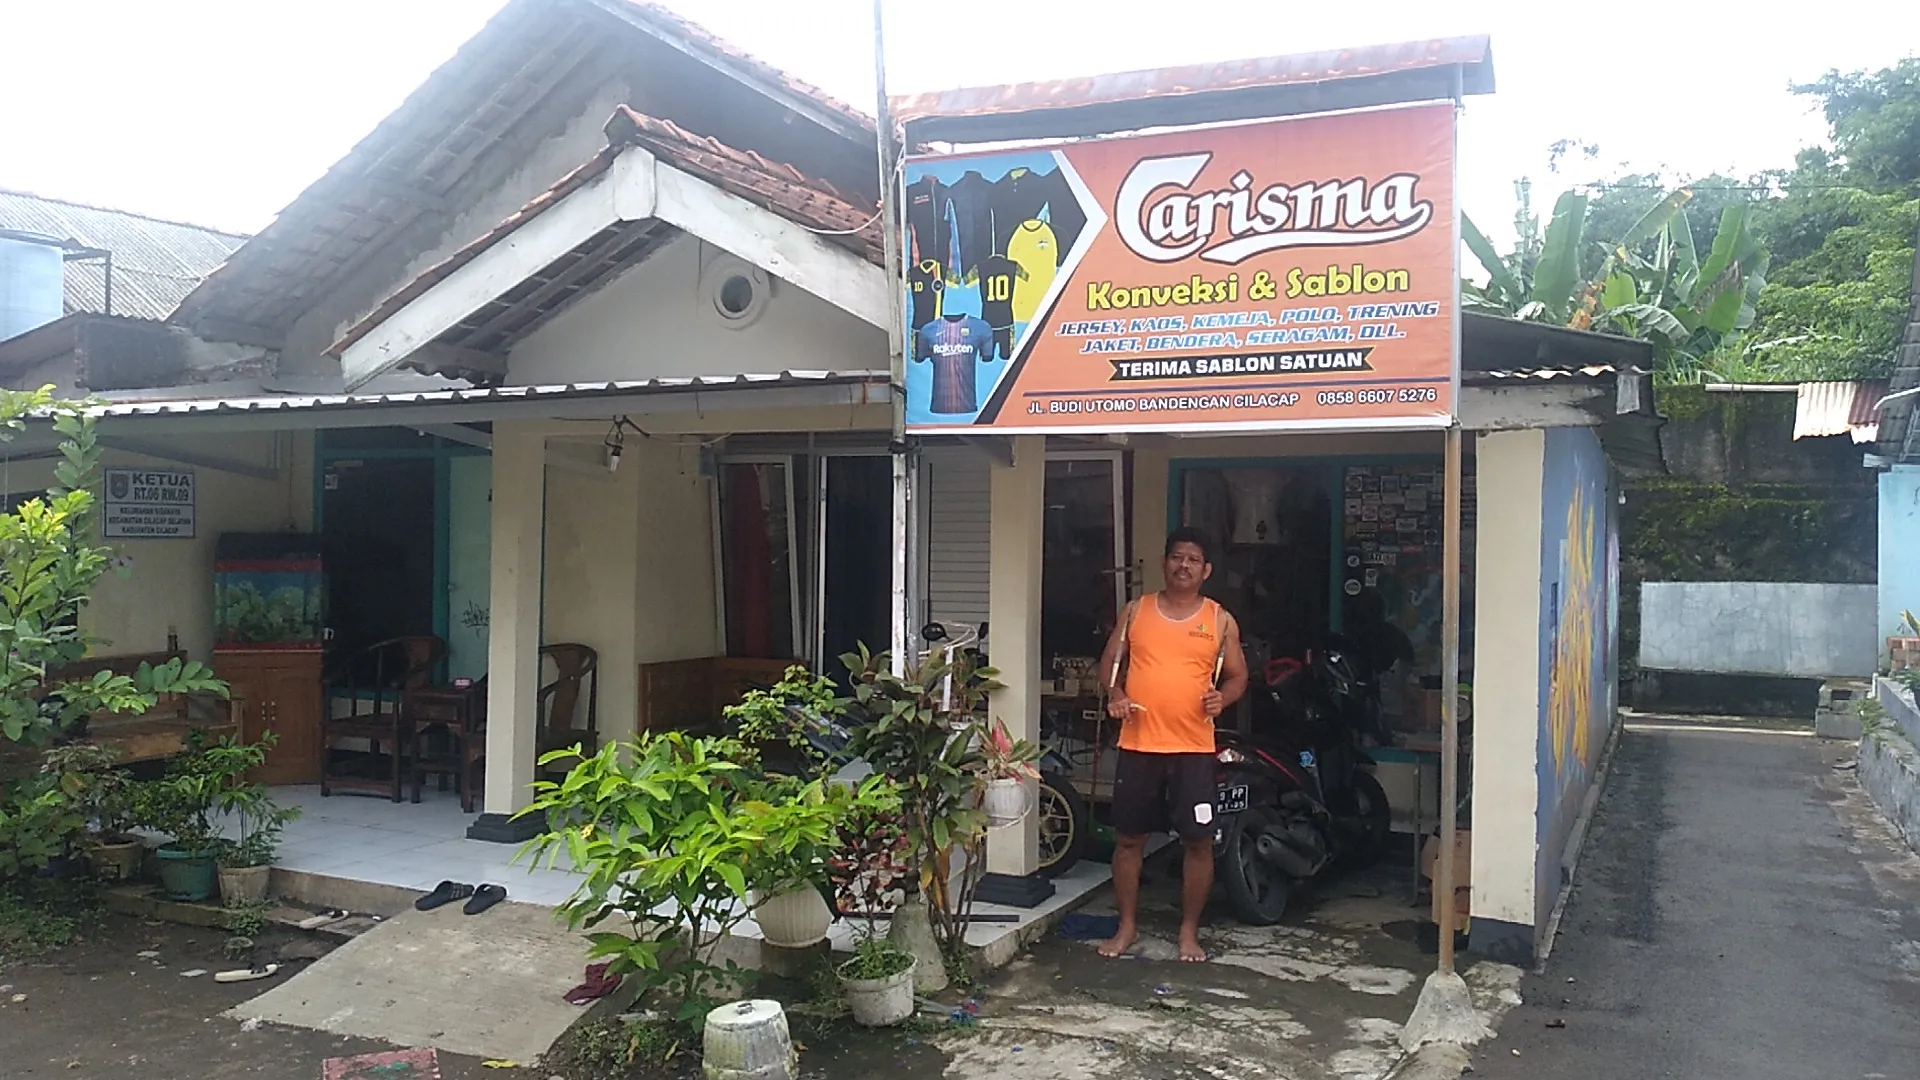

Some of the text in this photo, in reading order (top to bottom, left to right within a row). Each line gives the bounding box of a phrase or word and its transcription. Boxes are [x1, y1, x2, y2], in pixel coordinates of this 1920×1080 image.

[1114, 151, 1434, 265] Carisma
[914, 281, 923, 292] 10
[987, 274, 1009, 301] 10
[1087, 264, 1409, 310] Konveksi & Sablon
[1056, 301, 1439, 336] JERSEY, KAOS, KEMEJA, POLO, TRENING
[933, 343, 973, 356] Rakuten
[1081, 323, 1406, 354] JAKET, BENDERA, SERAGAM, DLL.
[1119, 352, 1363, 377] TERIMA SABLON SATUAN
[1027, 393, 1301, 414] JL. BUDI UTOMO BANDENGAN CILACAP
[1317, 388, 1437, 405] 0858 6607 5276
[132, 473, 190, 487] KETUA
[134, 487, 159, 501] RT.06
